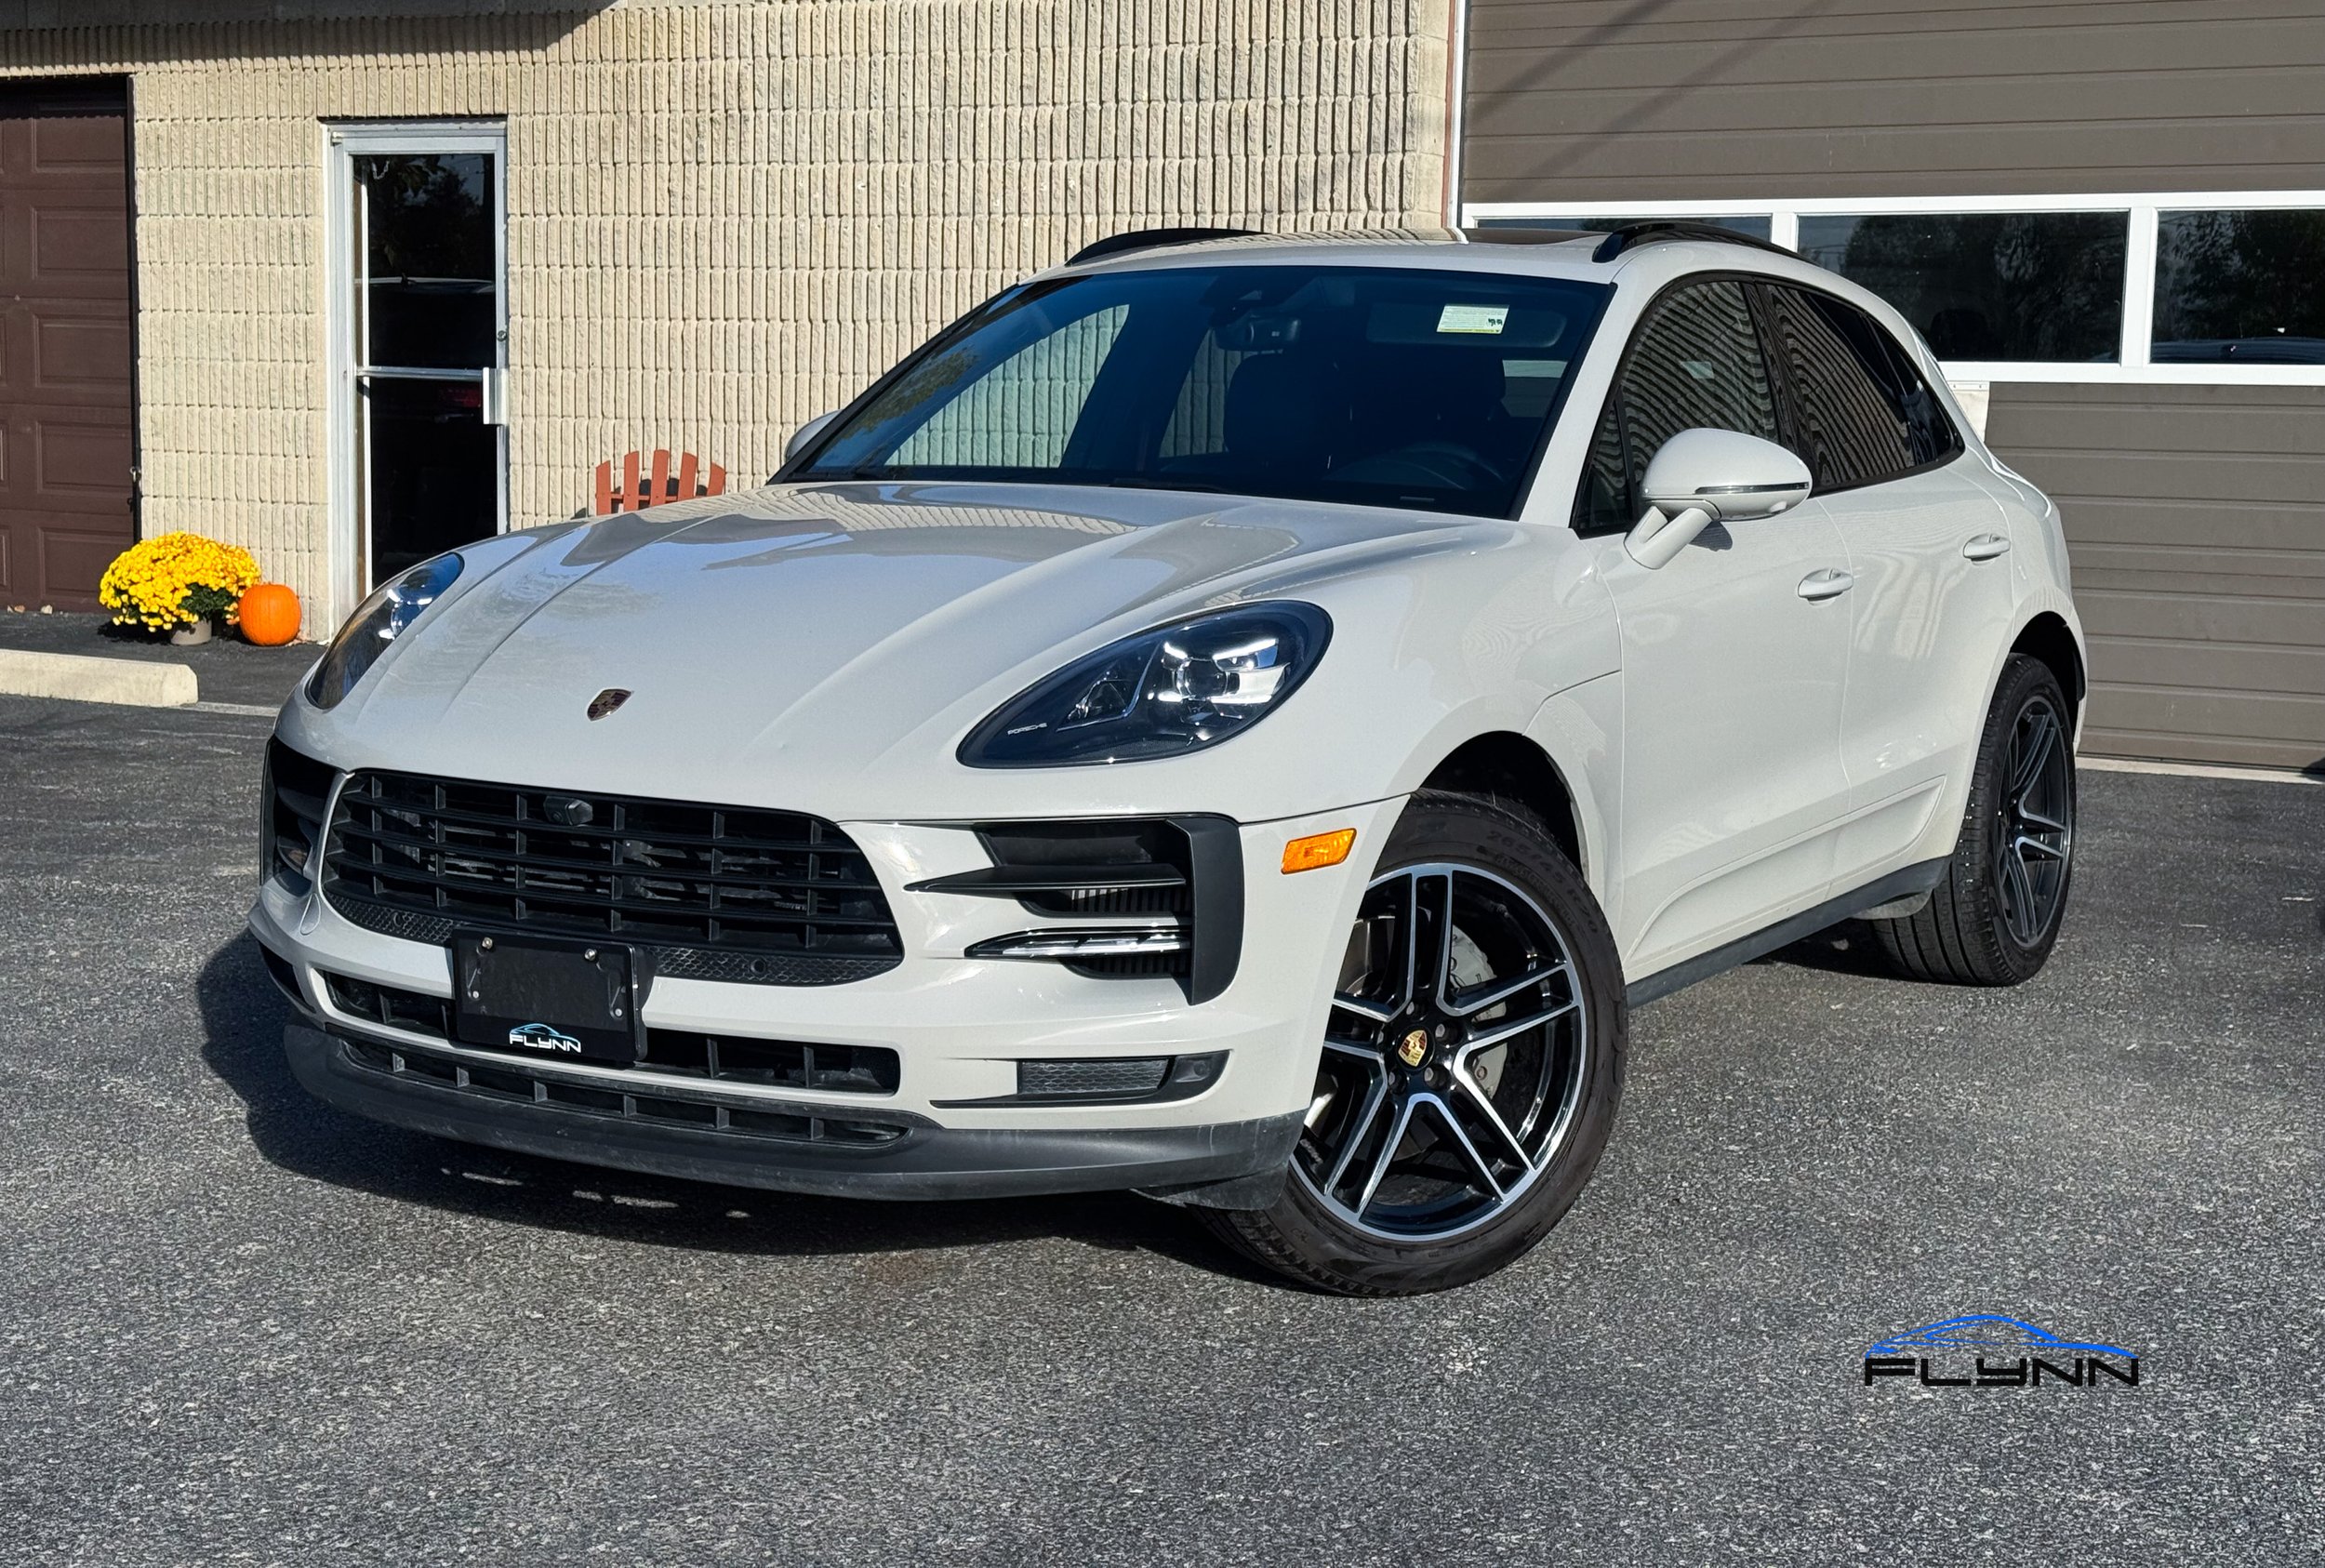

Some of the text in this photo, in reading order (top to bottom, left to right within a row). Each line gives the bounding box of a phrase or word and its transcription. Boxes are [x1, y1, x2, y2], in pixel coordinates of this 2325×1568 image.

[1007, 723, 1047, 735] PORSCHE
[1486, 830, 1565, 884] 265/45
[1566, 888, 1598, 933] R20
[509, 1033, 582, 1054] FLYNN
